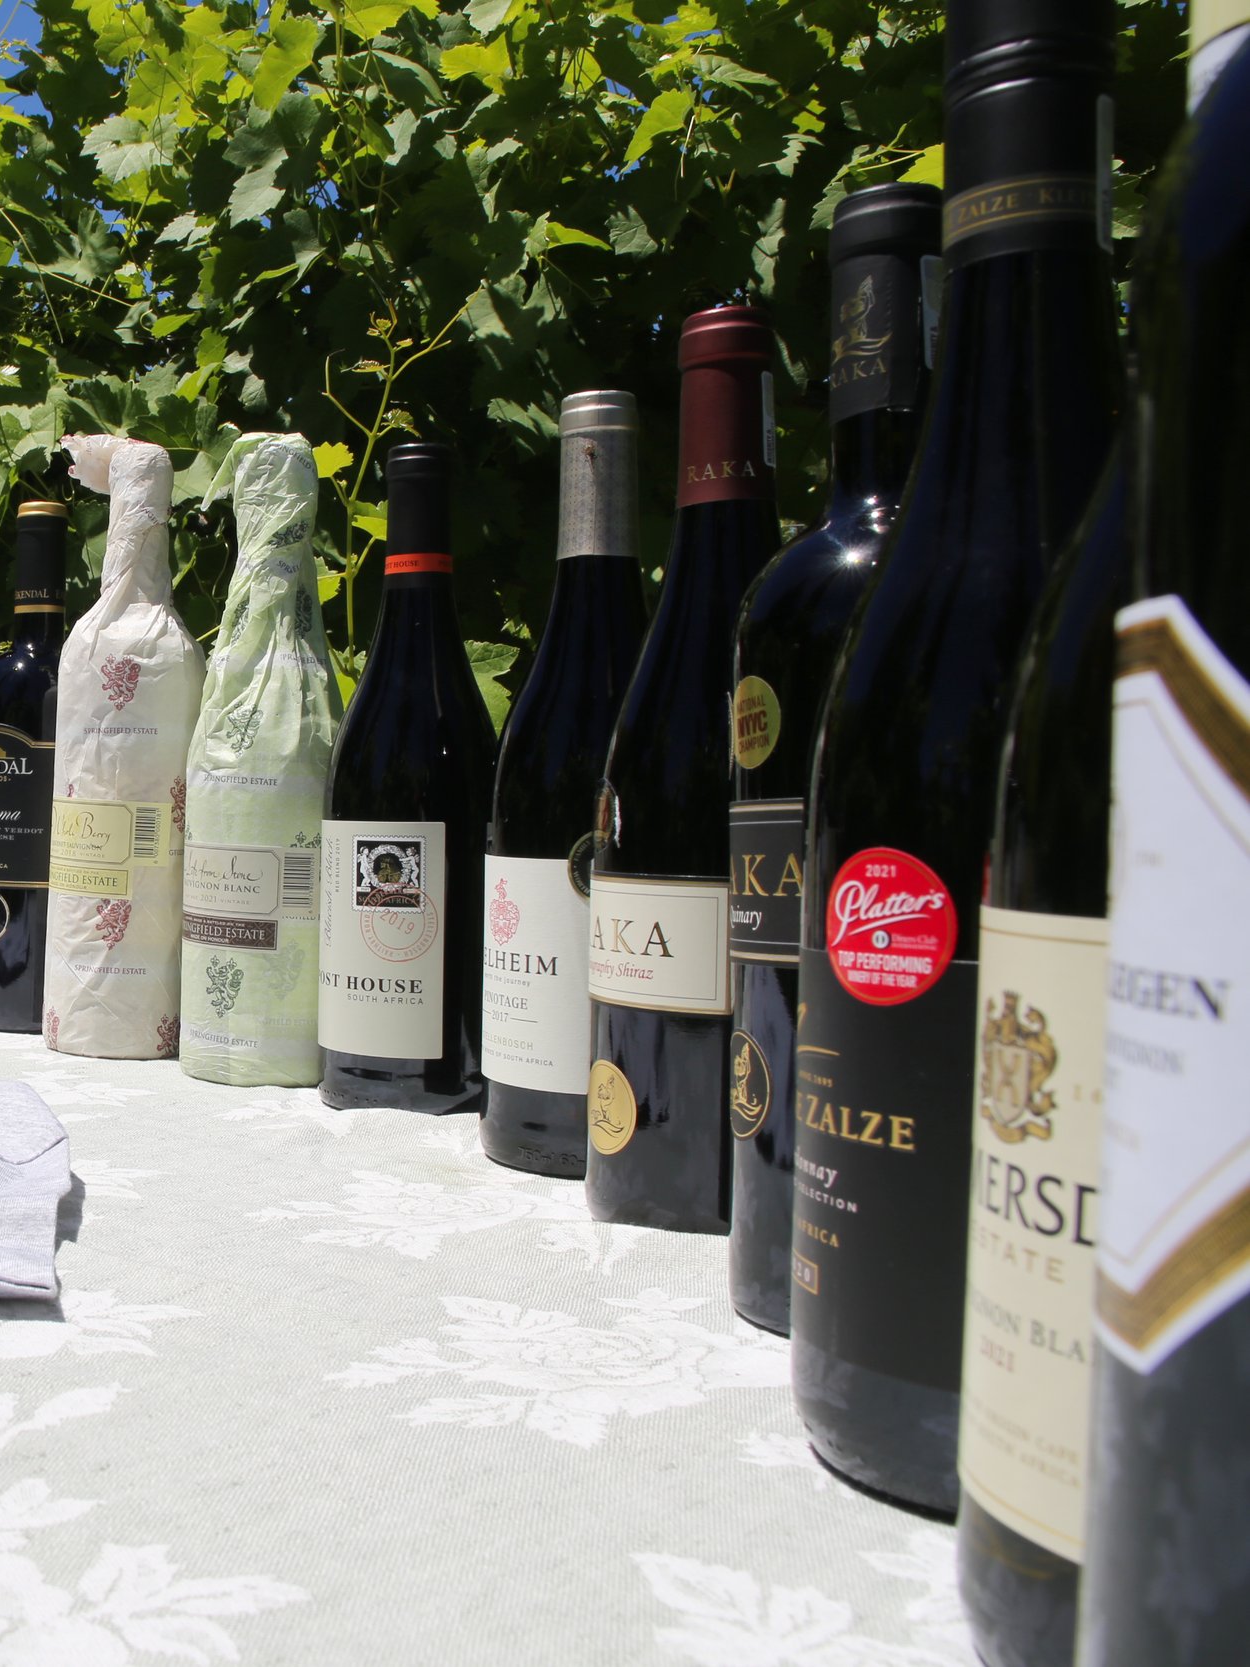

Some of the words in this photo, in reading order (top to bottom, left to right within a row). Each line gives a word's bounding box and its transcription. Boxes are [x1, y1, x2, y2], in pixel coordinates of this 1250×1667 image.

[958, 192, 1020, 223] ZALZE
[687, 460, 756, 484] RAKA
[133, 727, 158, 735] ESTATE
[737, 711, 768, 738] NYC
[250, 777, 278, 786] ESTATE
[76, 811, 111, 848] Berry
[865, 864, 896, 878] 2021
[82, 875, 118, 887] ESTATE
[224, 884, 261, 893] BLANC
[380, 908, 415, 934] 2019
[831, 880, 946, 947] Platter's
[225, 927, 266, 940] ESTATE
[590, 915, 674, 958] AKA
[122, 967, 147, 975] ESTATE
[615, 961, 654, 980] Shiraz
[838, 950, 856, 967] TOP
[856, 952, 933, 975] PERFORMING
[346, 976, 423, 994] HOUSE
[896, 974, 918, 988] YEAR
[347, 993, 378, 1003] SOUTH
[383, 995, 424, 1005] AFRICA
[484, 990, 528, 1010] PINOTAGE
[492, 1009, 509, 1023] 2017
[231, 1038, 258, 1048] ESTATE
[503, 1053, 523, 1063] SOUTH
[525, 1057, 554, 1067] AFRICA
[806, 1093, 917, 1151] ZALZE
[1028, 1319, 1097, 1367] BLA
